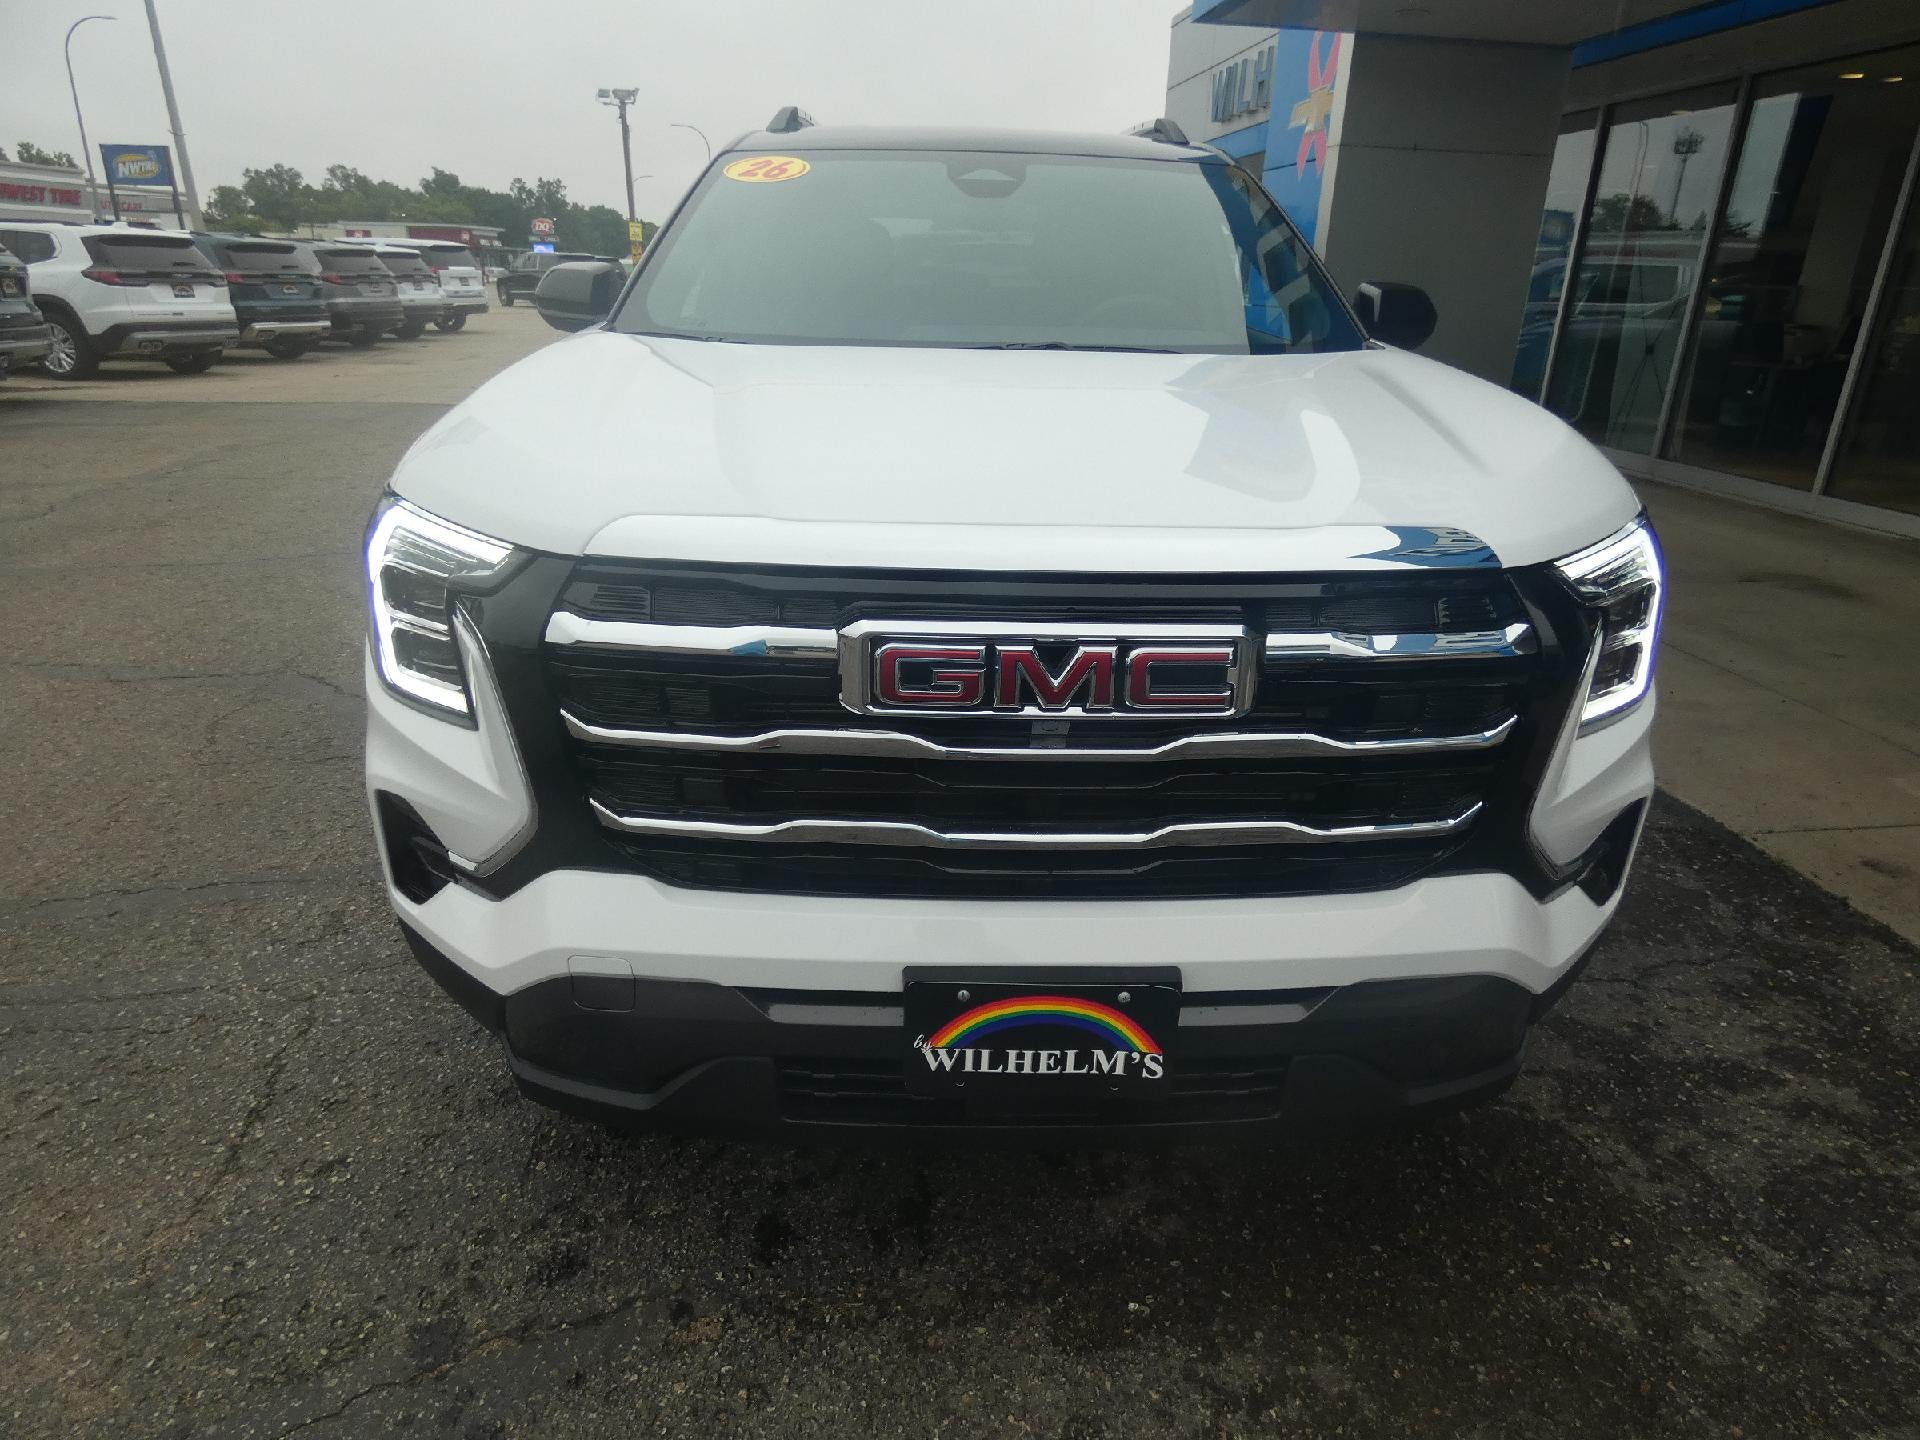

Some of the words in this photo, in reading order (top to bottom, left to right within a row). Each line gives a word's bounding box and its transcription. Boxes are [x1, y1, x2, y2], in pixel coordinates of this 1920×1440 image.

[738, 159, 795, 179] 26
[535, 221, 550, 232] DQ
[873, 641, 1235, 709] GMC
[913, 1034, 933, 1053] by
[920, 1047, 1165, 1080] WILHELM'S
